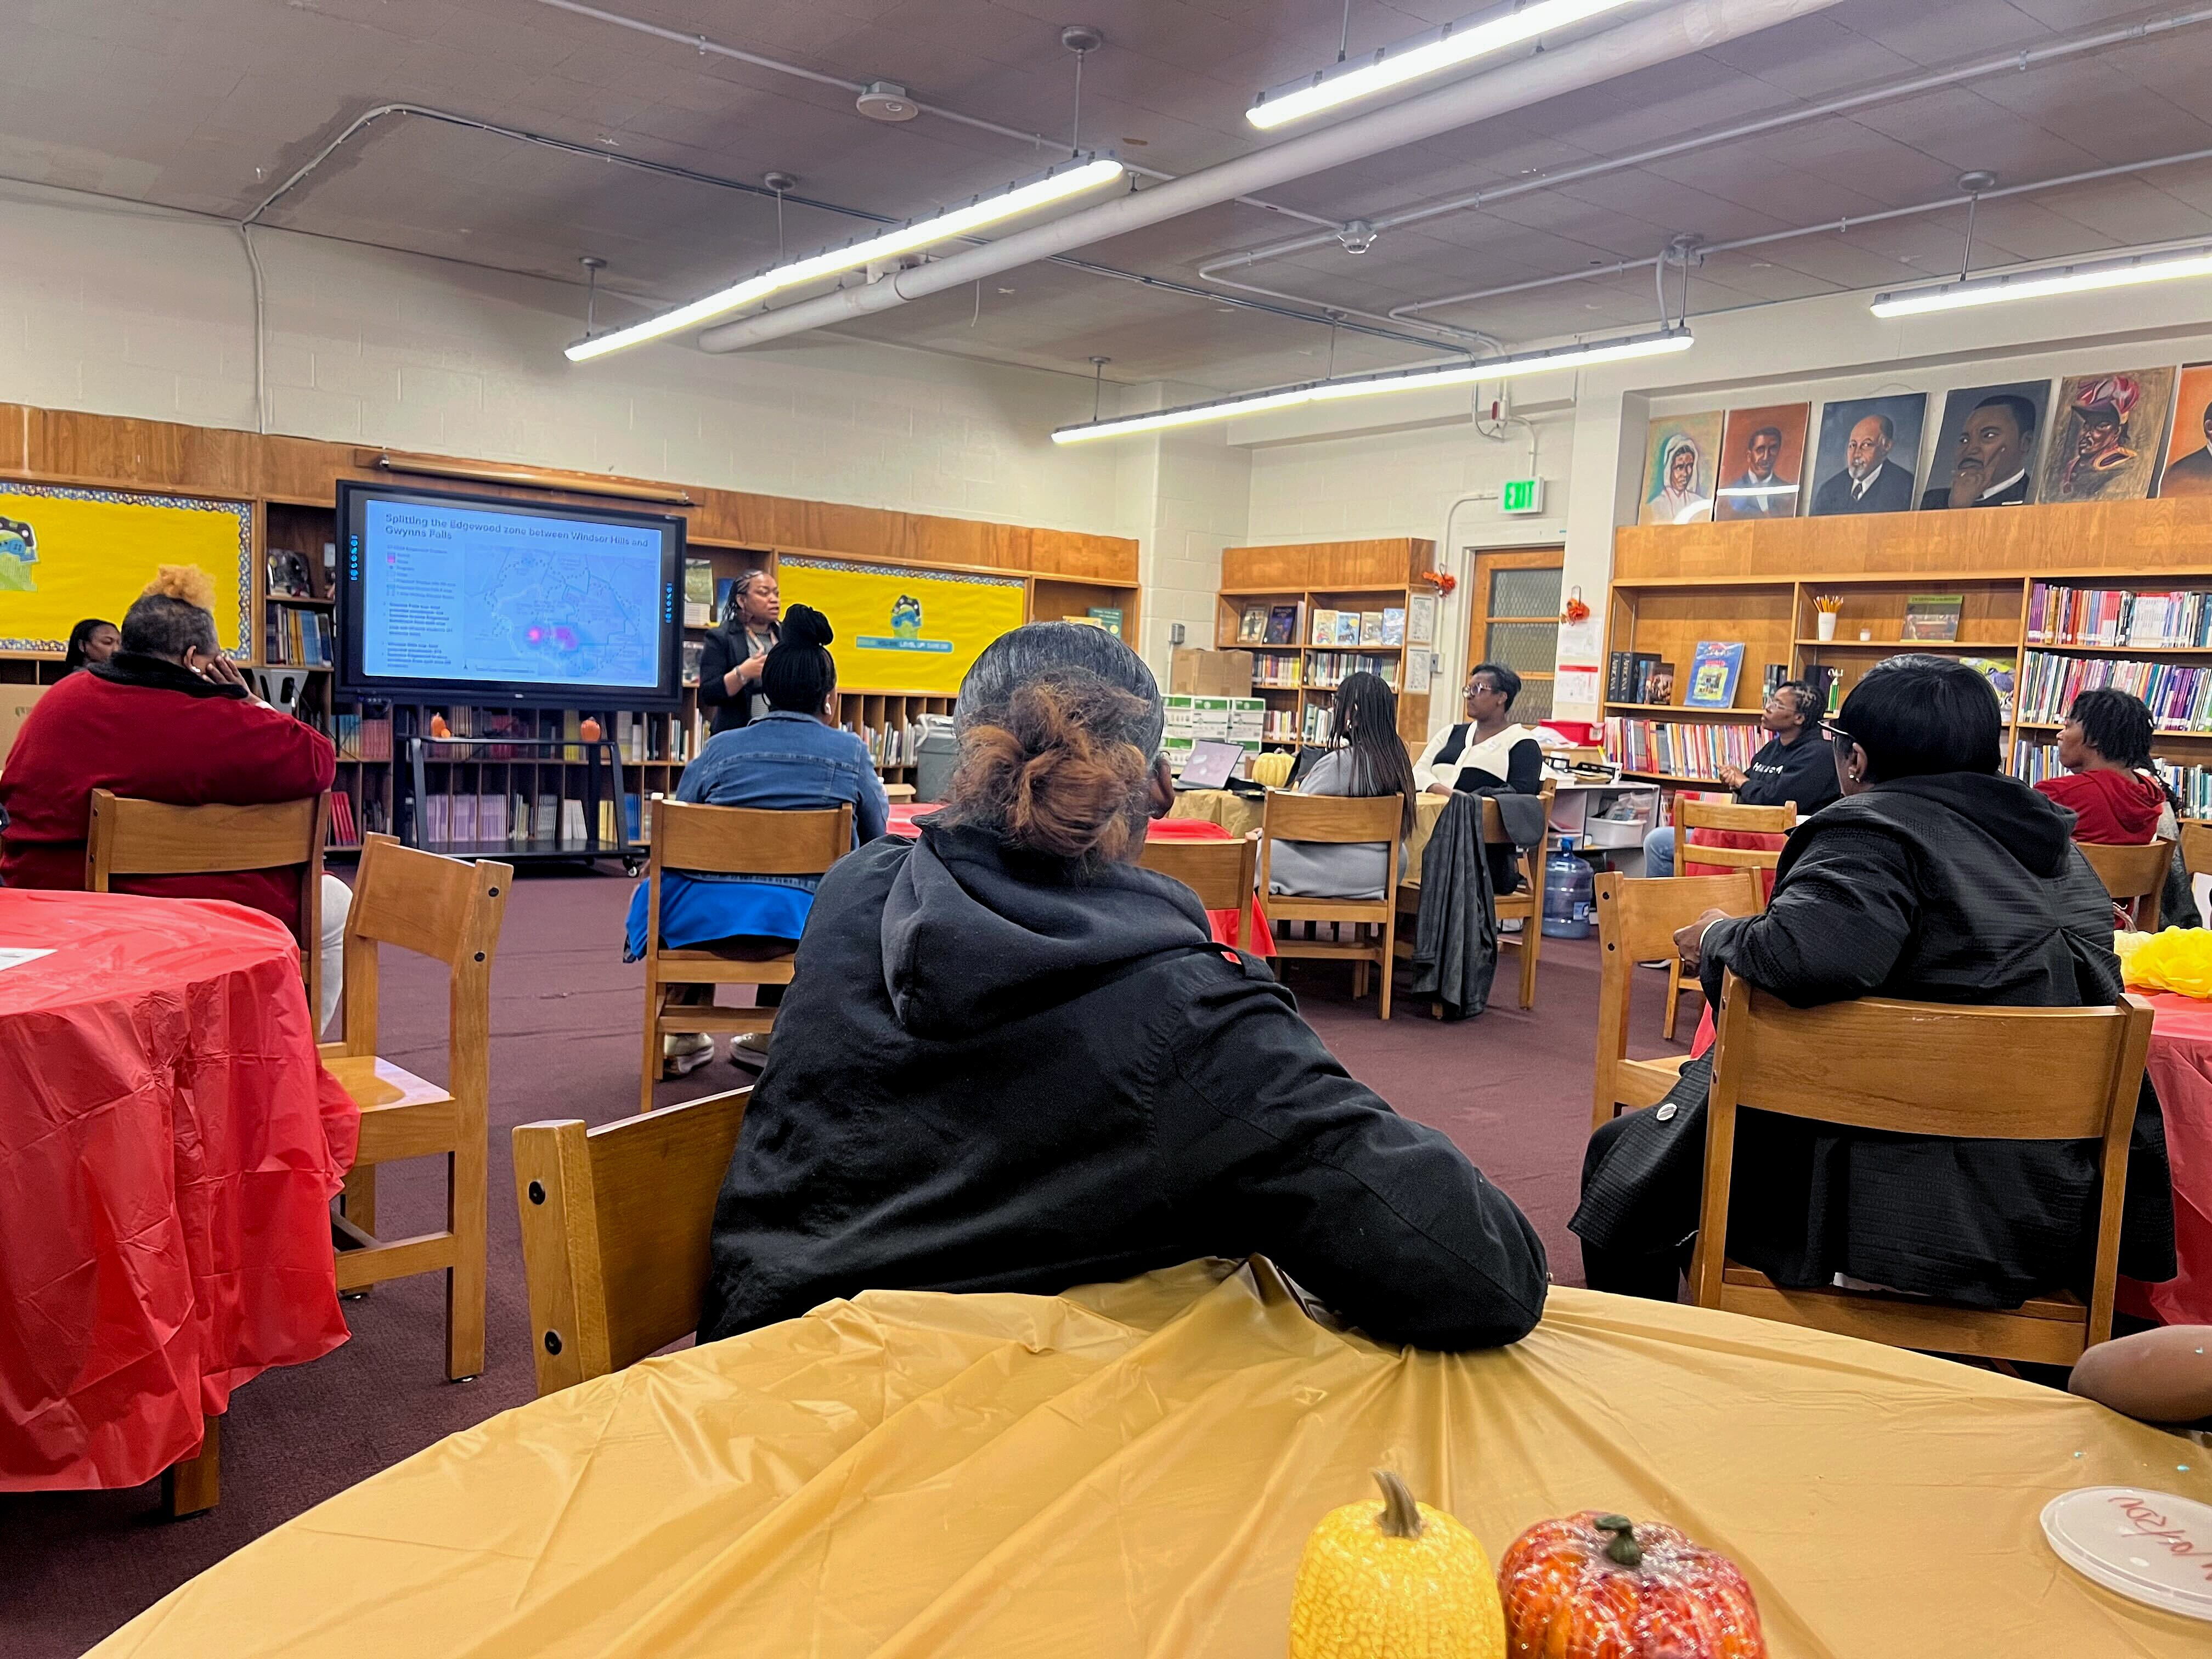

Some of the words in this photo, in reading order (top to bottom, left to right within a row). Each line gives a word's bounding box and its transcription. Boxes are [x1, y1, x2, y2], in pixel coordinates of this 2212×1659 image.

[1504, 481, 1535, 510] EXIT
[386, 513, 428, 527] Splitting
[431, 518, 447, 527] the
[450, 520, 501, 533] Edgewood
[504, 526, 527, 534] zone
[529, 528, 569, 539] between
[571, 531, 608, 543] Windsor
[611, 535, 629, 545] Hills
[631, 539, 648, 547] and
[386, 525, 426, 538] Gwynns
[430, 529, 452, 540] Falls
